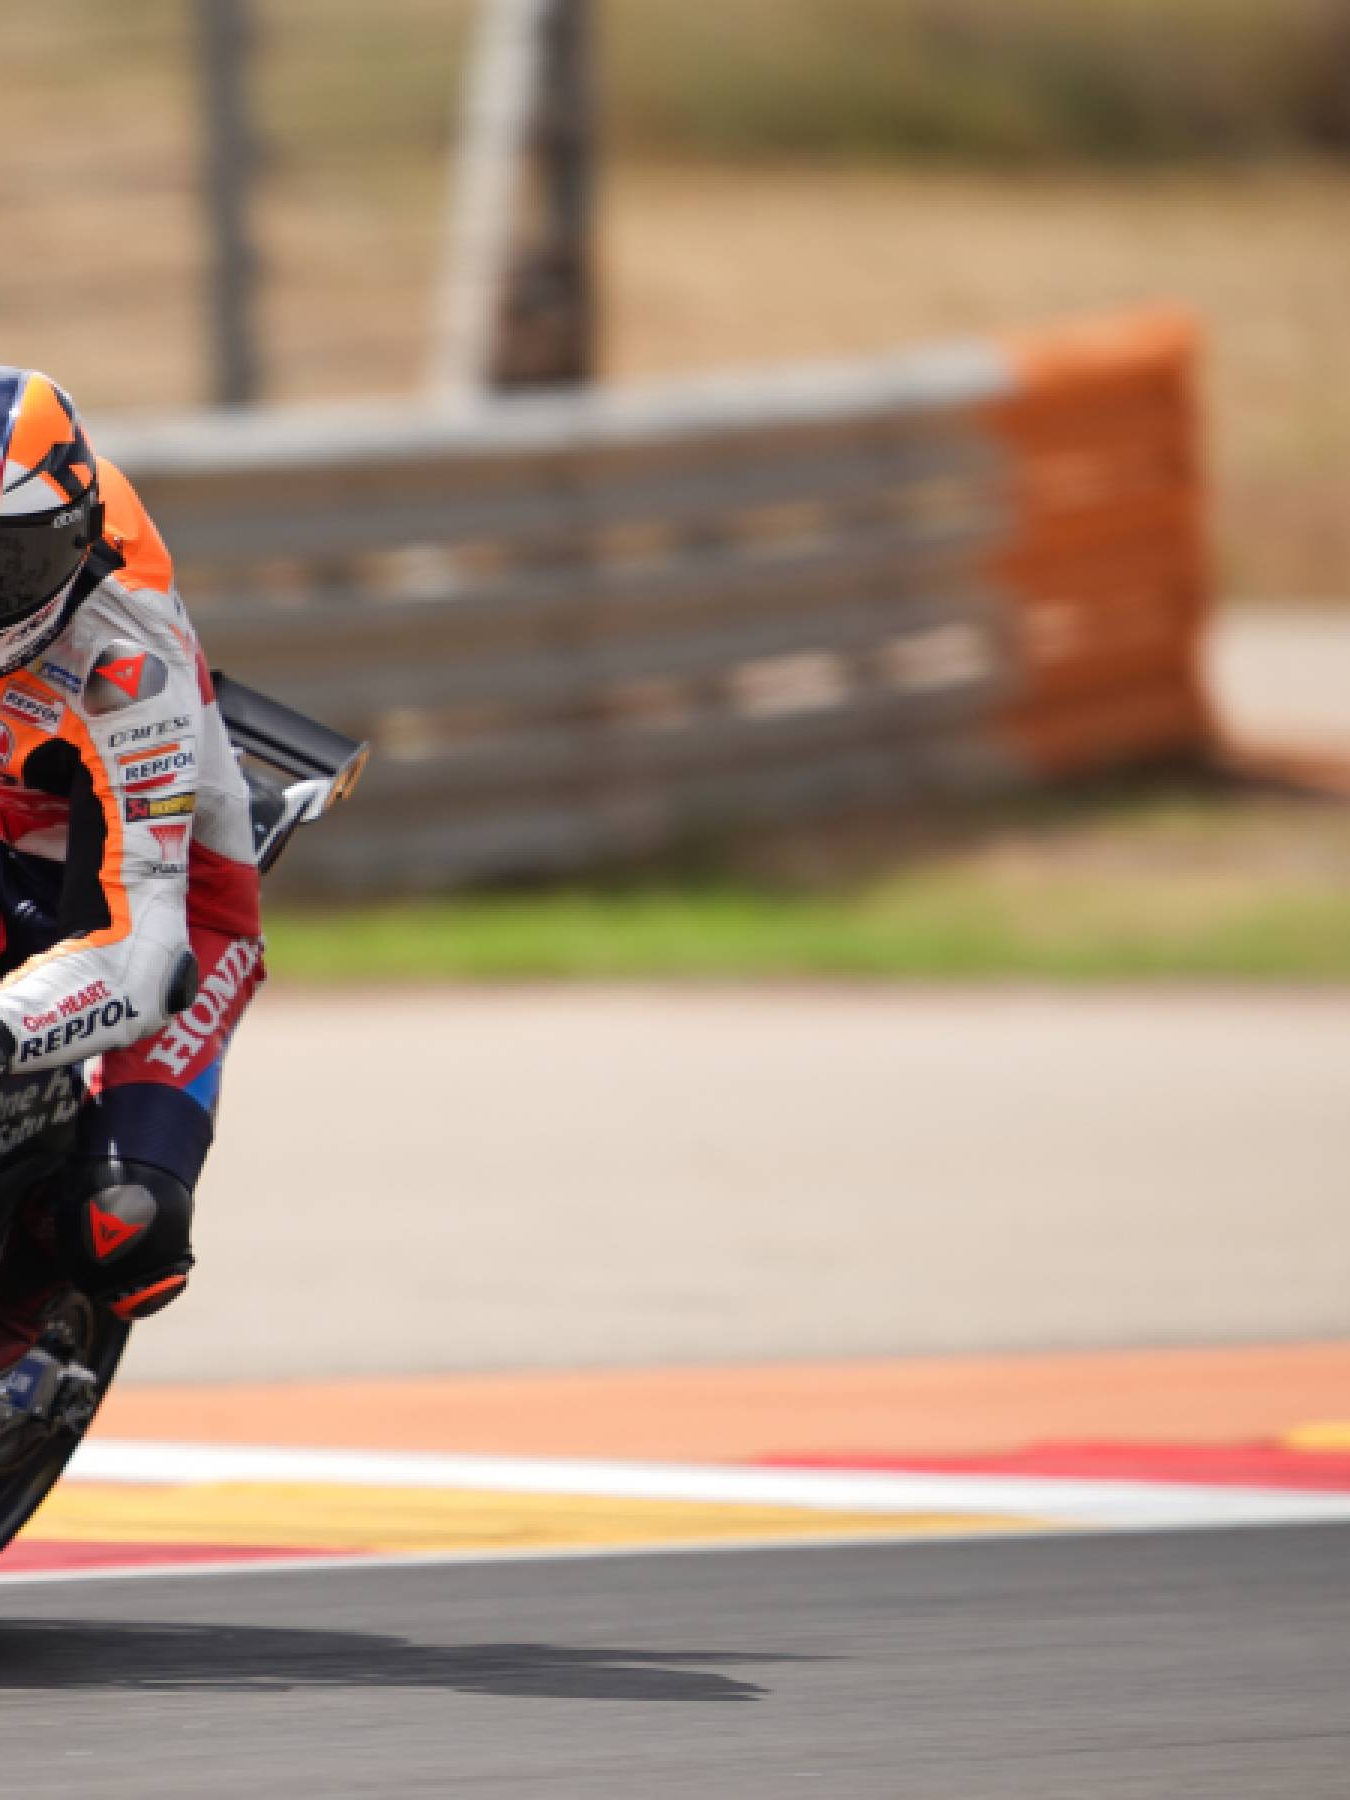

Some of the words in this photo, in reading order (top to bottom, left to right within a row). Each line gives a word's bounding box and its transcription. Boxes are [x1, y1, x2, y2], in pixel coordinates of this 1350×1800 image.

[5, 690, 61, 724] REPSOL
[125, 751, 197, 781] REPSOL
[19, 995, 141, 1063] REPSOL
